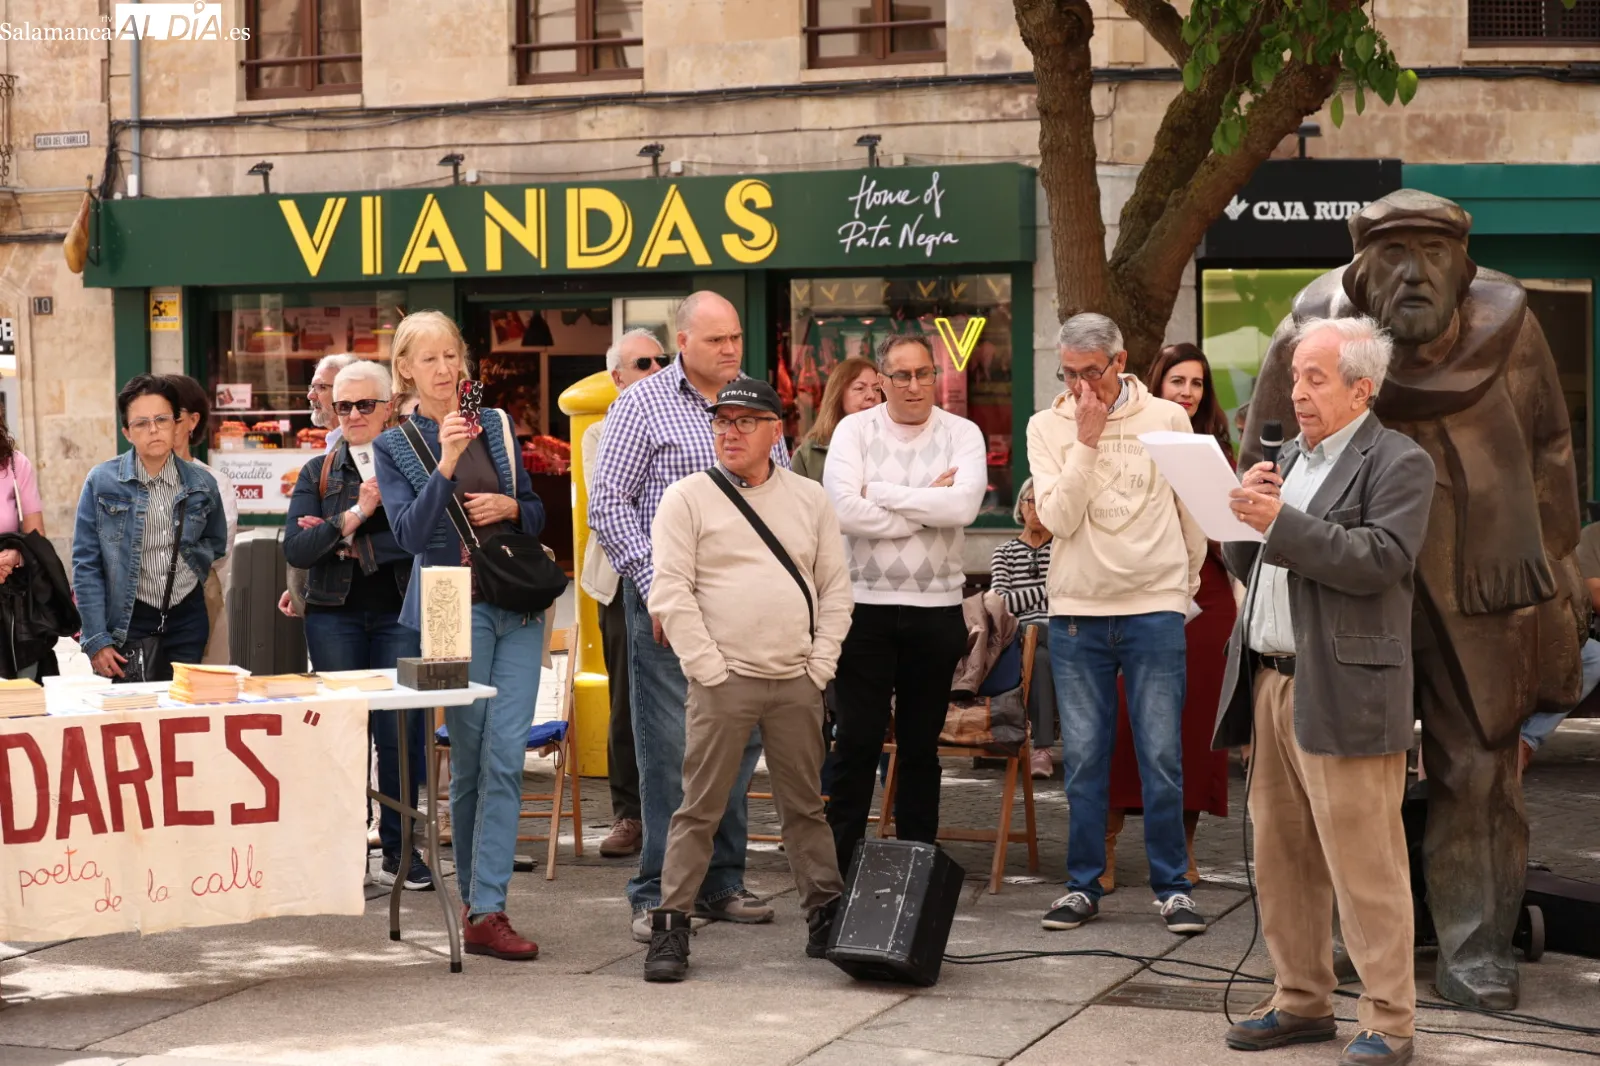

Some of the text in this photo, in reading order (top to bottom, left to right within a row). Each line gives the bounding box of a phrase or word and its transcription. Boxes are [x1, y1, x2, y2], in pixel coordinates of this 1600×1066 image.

[848, 171, 946, 219] Home of
[1252, 200, 1372, 222] CAJA RUR
[278, 178, 778, 278] VIANDAS
[837, 213, 959, 257] Pata Negra
[34, 297, 50, 313] 10
[934, 317, 986, 372] V
[721, 389, 758, 398] STRALIS
[220, 467, 273, 480] Bocadillo
[1129, 474, 1144, 489] 76
[1094, 505, 1130, 519] CRICKET
[19, 845, 103, 907] poeta
[94, 844, 263, 912] de la calle
